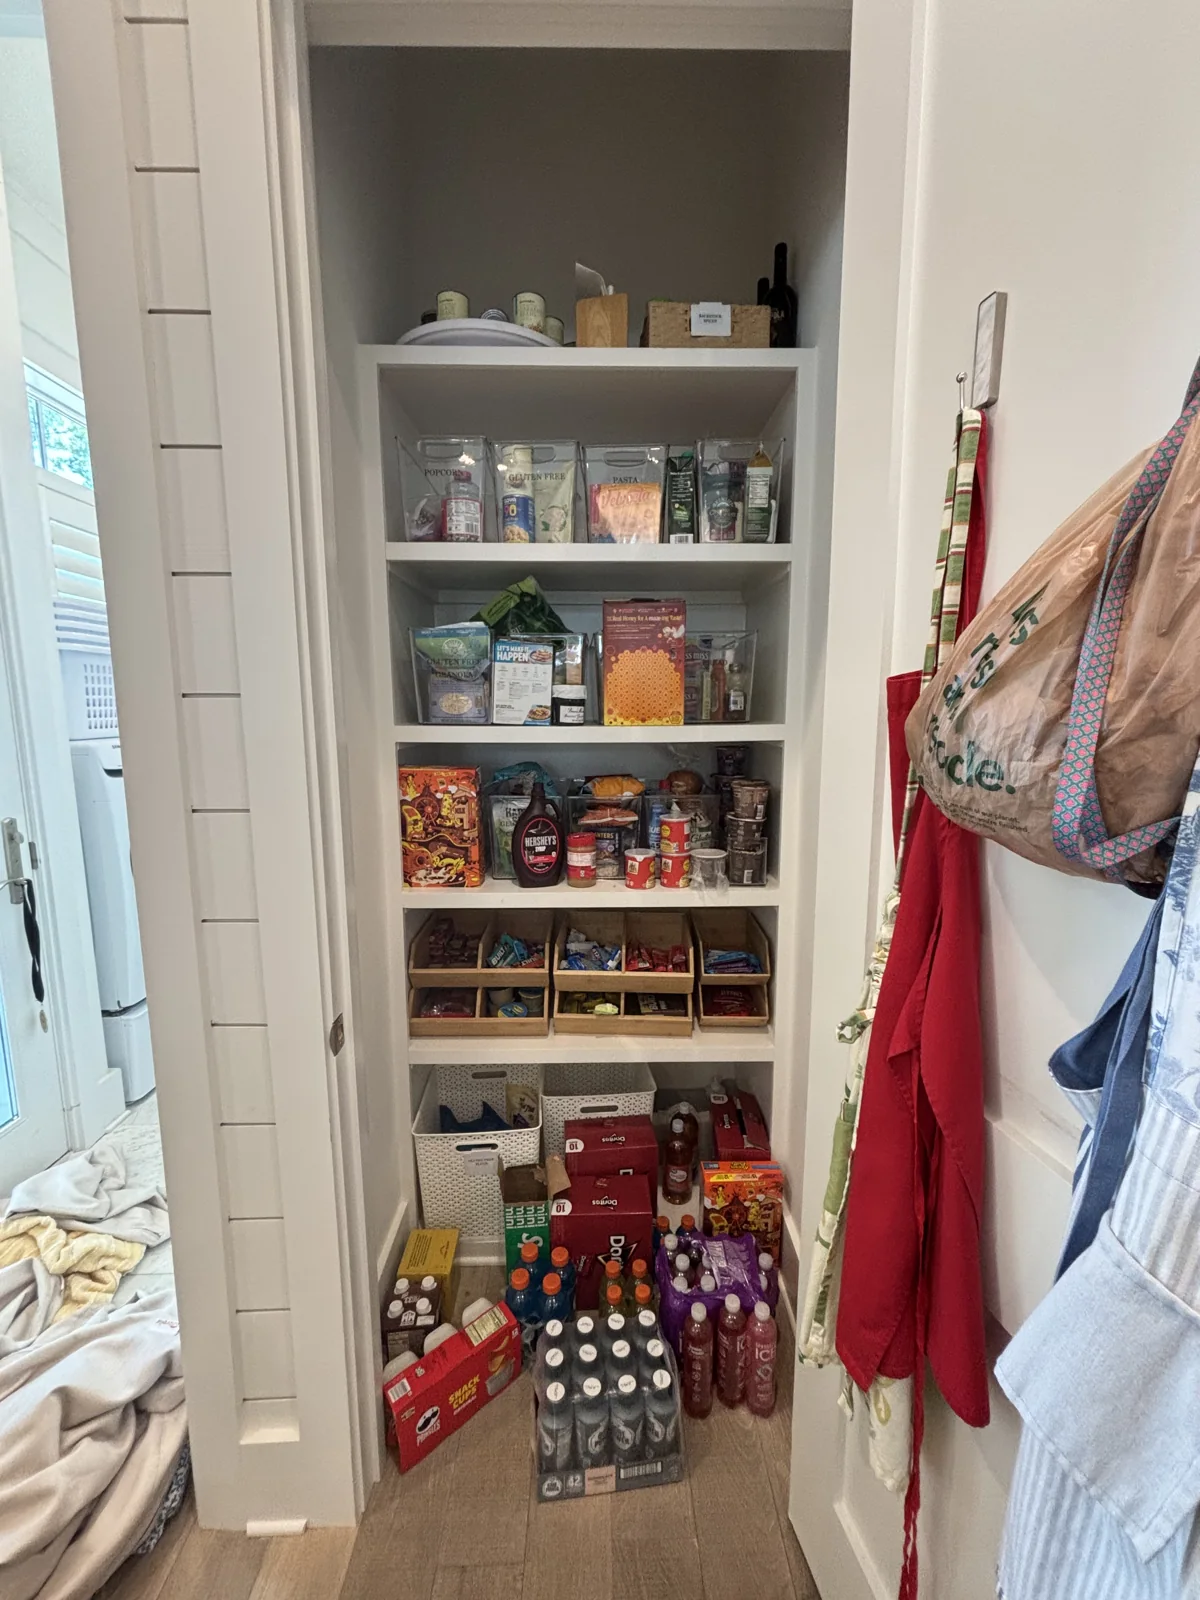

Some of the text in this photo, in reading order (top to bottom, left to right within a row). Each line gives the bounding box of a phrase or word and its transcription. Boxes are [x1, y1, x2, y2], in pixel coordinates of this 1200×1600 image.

[424, 468, 464, 476] POPCORN
[508, 472, 566, 481] GLUTEN FREE
[612, 476, 638, 484] PASTA
[496, 651, 530, 662] HAPPEN
[524, 836, 556, 847] HERSHEY'S
[556, 1204, 566, 1213] 10
[448, 1374, 480, 1404] SNACK
[452, 1386, 478, 1410] CUPS
